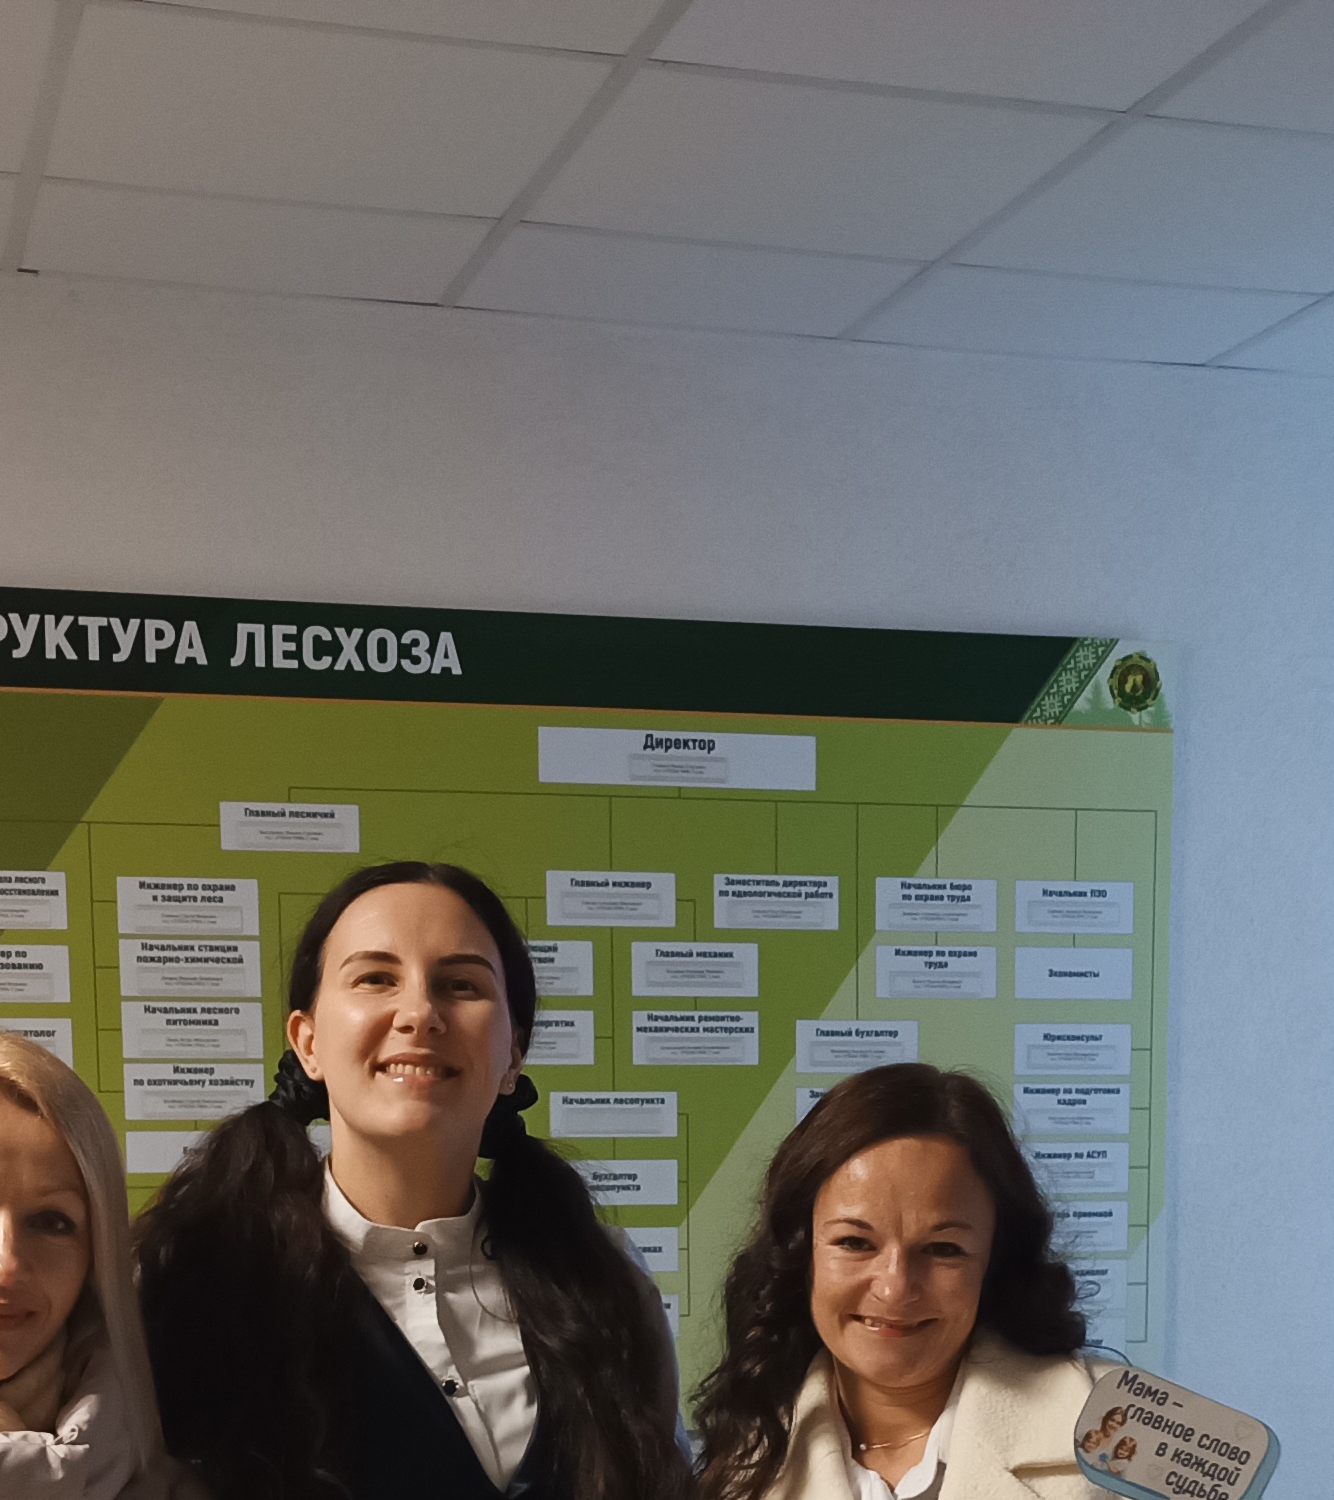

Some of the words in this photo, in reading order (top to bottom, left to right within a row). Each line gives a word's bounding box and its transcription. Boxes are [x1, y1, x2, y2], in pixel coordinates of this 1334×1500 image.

[230, 622, 463, 675] ЛЕСХОЗА
[643, 733, 716, 754] Директор
[244, 807, 286, 818] Главный
[288, 809, 335, 819] лесничий
[14, 876, 46, 885] лесного
[570, 877, 610, 888] Главный
[611, 880, 652, 890] инженер
[724, 876, 780, 888] Заместитель
[782, 879, 828, 890] директора
[139, 880, 184, 893] Инженер
[186, 883, 199, 892] по
[201, 883, 236, 893] охране
[900, 880, 947, 891] Начальник
[949, 881, 973, 893] бюро
[718, 889, 729, 898] по
[731, 888, 803, 900] идеологической
[804, 889, 834, 901] работе
[902, 893, 913, 902] по
[914, 893, 945, 903] охране
[947, 894, 971, 904] труда
[1042, 888, 1088, 898] Начальник
[160, 894, 198, 904] защите
[199, 895, 224, 904] леса
[140, 942, 196, 952] Начальник
[197, 944, 238, 954] станции
[655, 948, 693, 958] Главный
[695, 950, 735, 958] механик
[894, 948, 934, 959] Инженер
[935, 949, 946, 958] по
[947, 949, 978, 959] охране
[14, 950, 27, 959] по
[136, 954, 244, 965] пожарно-химической
[923, 960, 949, 969] труда
[1047, 968, 1100, 978] Экономисты
[143, 1004, 198, 1014] Начальник
[200, 1006, 241, 1015] лесного
[165, 1018, 219, 1027] питомника
[646, 1013, 696, 1022] Начальник
[697, 1014, 744, 1025] ремонтно-
[636, 1024, 701, 1034] механических
[702, 1025, 756, 1035] мастерских
[815, 1027, 854, 1037] Главный
[855, 1028, 899, 1038] бухгалтер
[1043, 1033, 1103, 1043] Юрисконсульт
[172, 1065, 215, 1076] Инженер
[133, 1078, 145, 1087] по
[147, 1078, 206, 1088] охотничьему
[208, 1077, 255, 1088] хозяйству
[1023, 1086, 1061, 1096] Инженер
[561, 1096, 611, 1105] Начальник
[613, 1097, 666, 1107] лесопункта
[1086, 1150, 1108, 1160] АСУП
[592, 1171, 638, 1182] Бухгалтер
[1117, 1370, 1170, 1407] Мама
[1124, 1403, 1195, 1442] главное
[1197, 1433, 1251, 1465] слово
[1155, 1441, 1168, 1457] в
[1170, 1448, 1241, 1487] каждой
